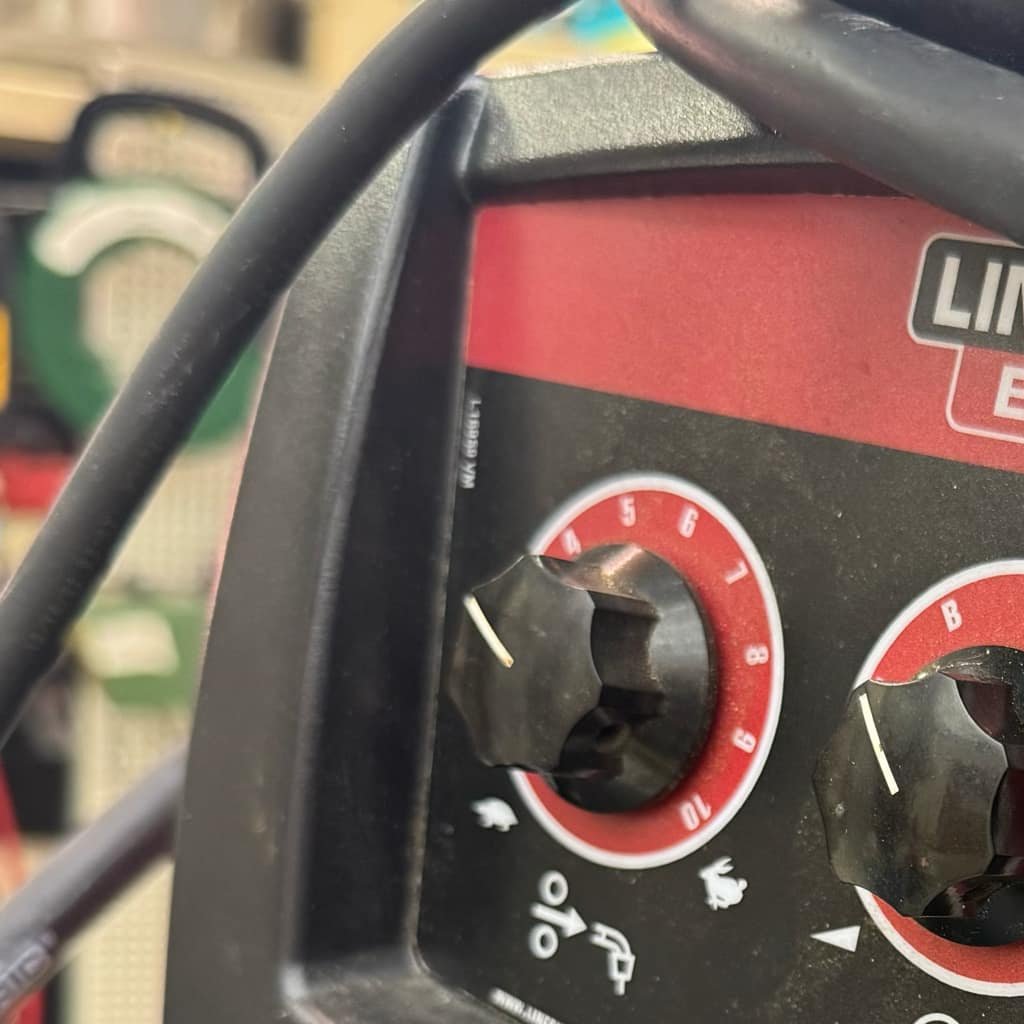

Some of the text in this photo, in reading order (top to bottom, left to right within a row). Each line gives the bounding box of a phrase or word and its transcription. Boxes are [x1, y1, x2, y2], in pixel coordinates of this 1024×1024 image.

[618, 496, 636, 527] 5
[677, 508, 699, 538] 6
[723, 562, 748, 586] 7
[941, 599, 962, 632] B
[745, 645, 769, 666] 8
[731, 727, 757, 754] 9
[679, 794, 711, 831] 10
